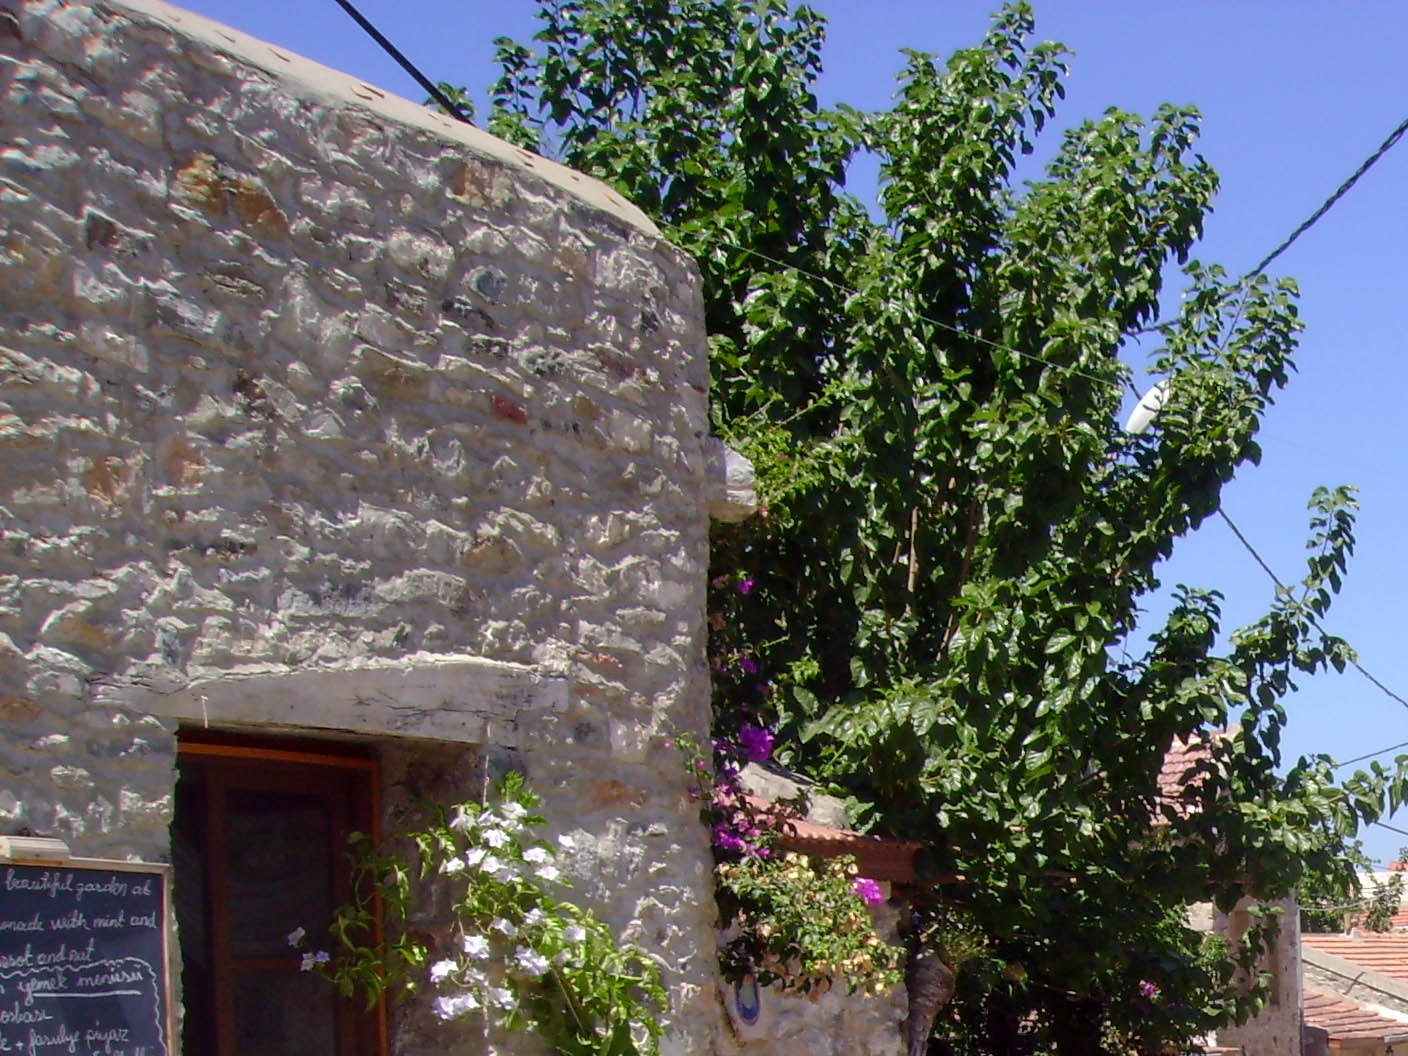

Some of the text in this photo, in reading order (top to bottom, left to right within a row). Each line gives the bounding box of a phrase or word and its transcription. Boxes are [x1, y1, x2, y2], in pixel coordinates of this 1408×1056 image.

[6, 868, 73, 898] beautiful
[76, 876, 128, 901] garden
[51, 909, 91, 930] with
[93, 909, 125, 928] mint
[130, 911, 158, 929] and
[37, 944, 66, 965] and
[18, 976, 69, 1006] yemek
[0, 1001, 53, 1024] orbası
